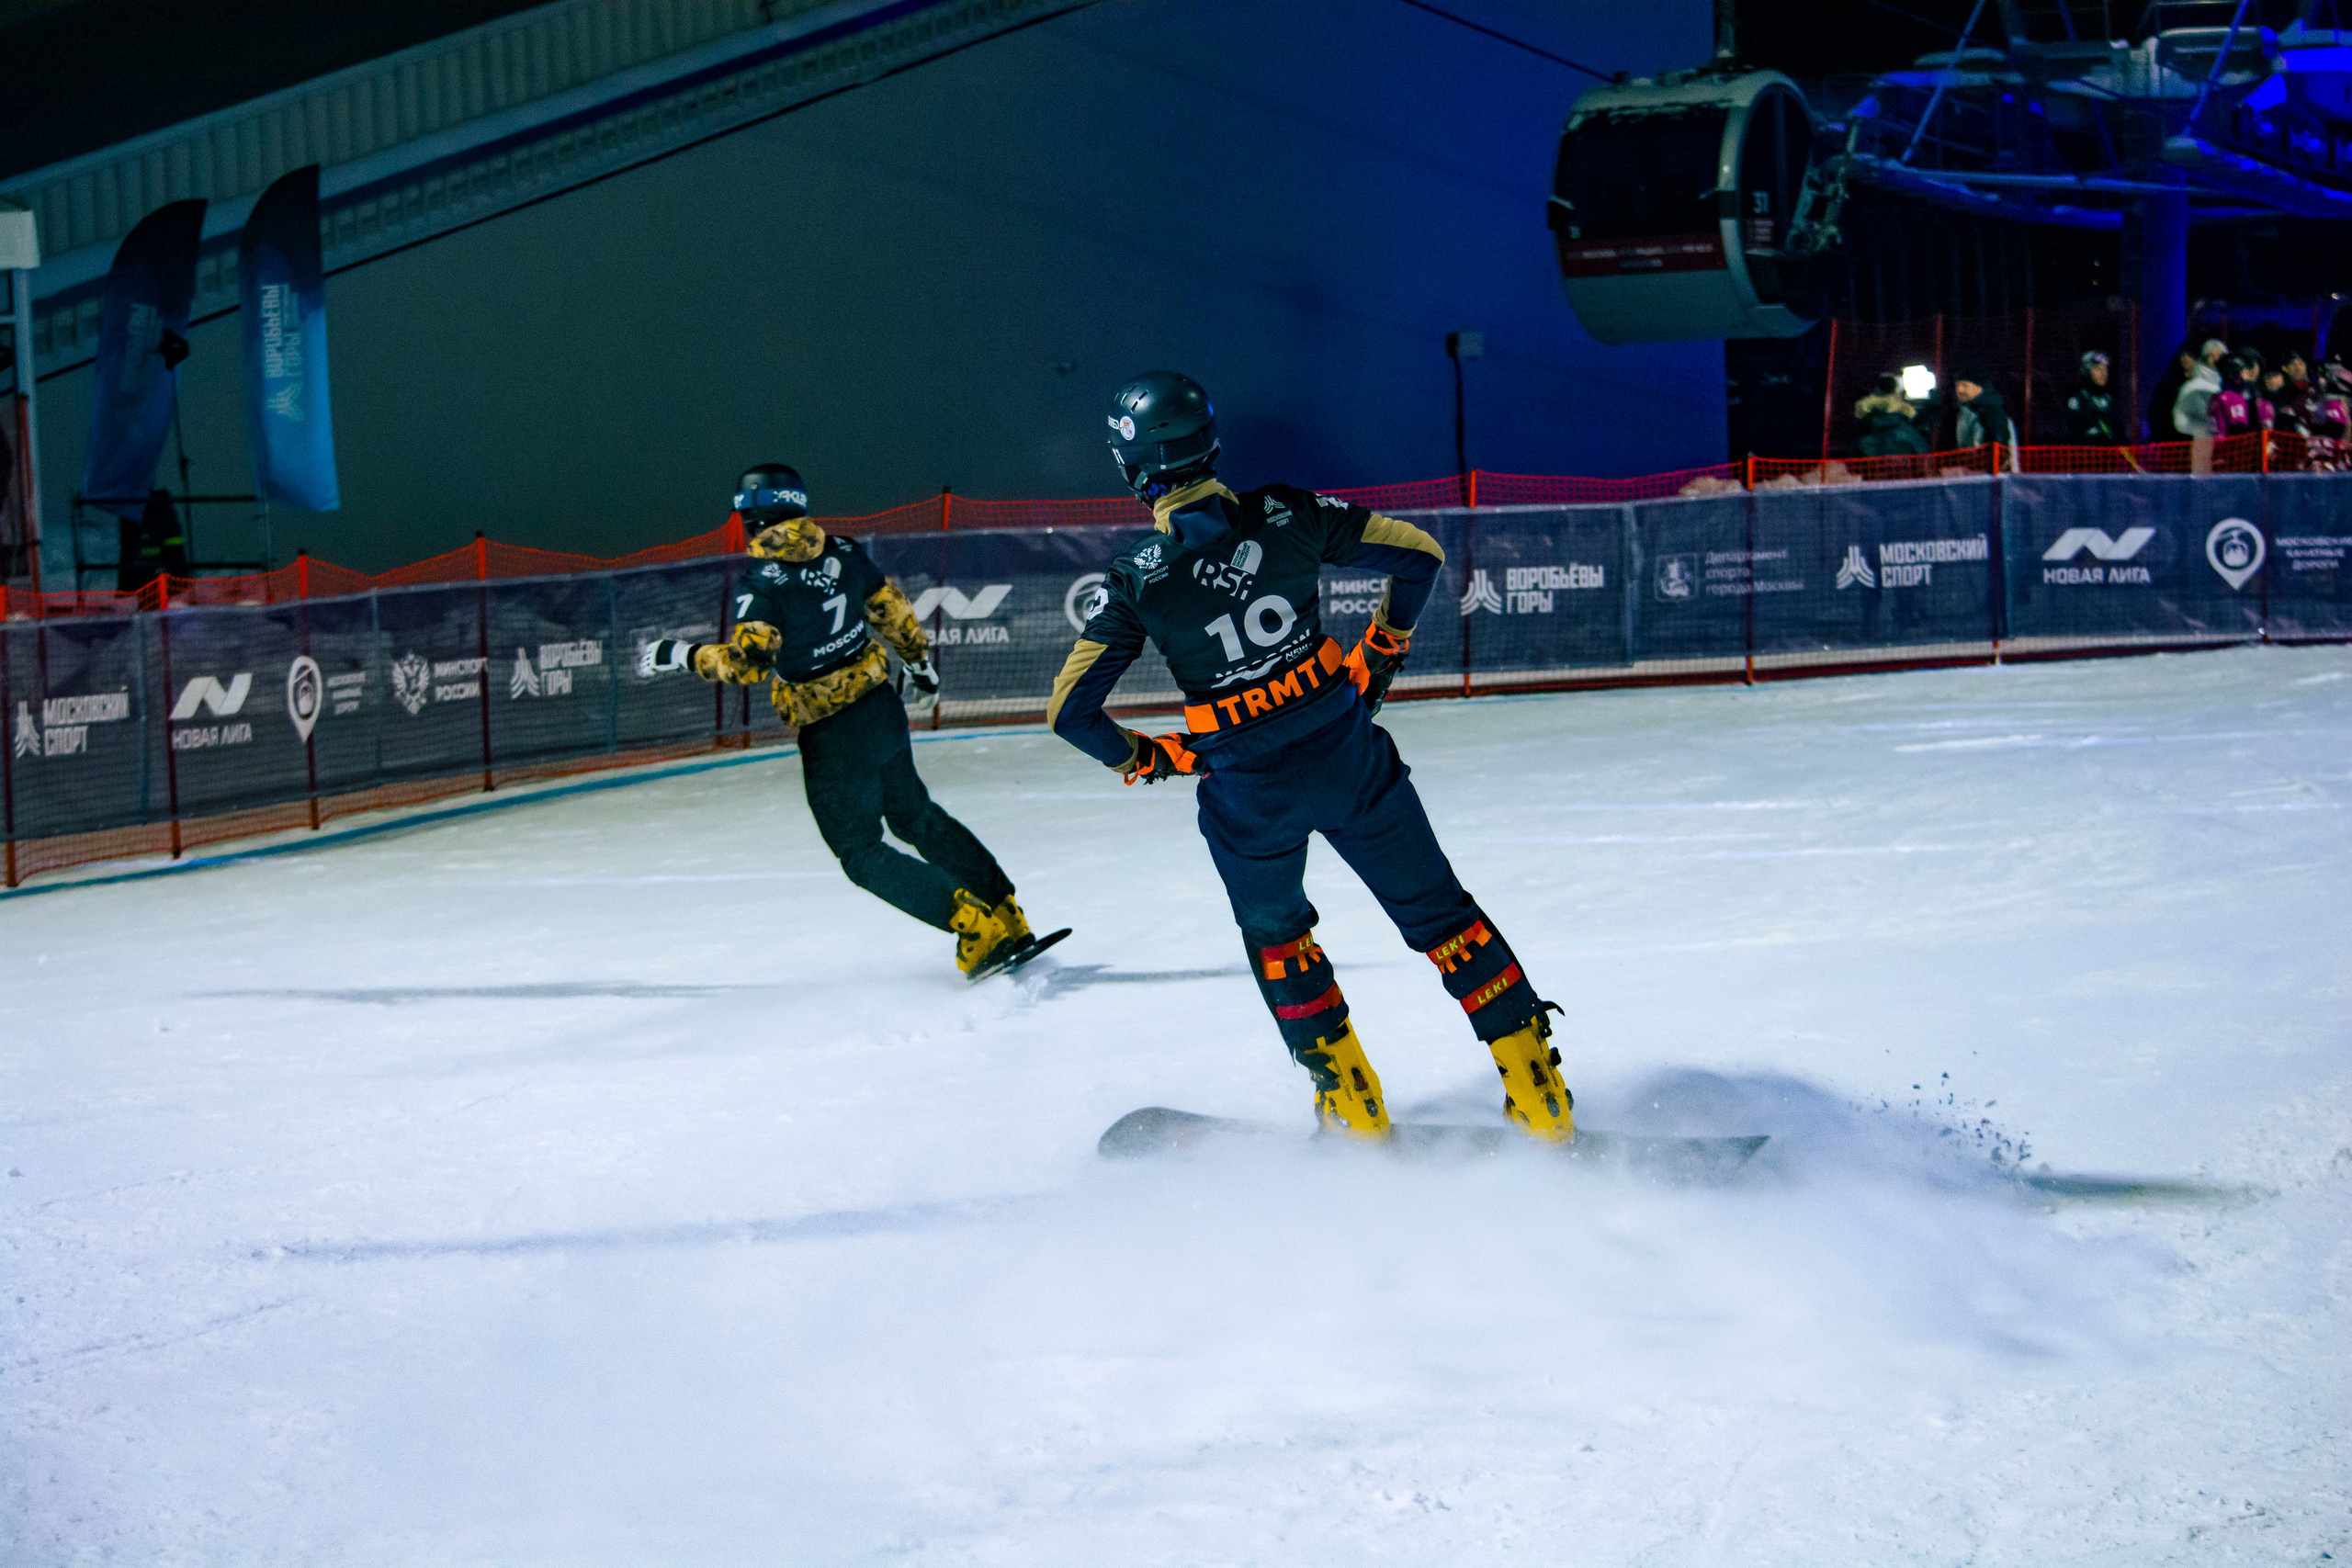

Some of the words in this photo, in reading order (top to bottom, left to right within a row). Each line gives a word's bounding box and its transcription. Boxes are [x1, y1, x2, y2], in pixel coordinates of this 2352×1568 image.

[1879, 533, 1989, 565] МОСКОВСКИЙ
[1329, 578, 1388, 596] МИНСП
[1506, 562, 1604, 591] ВОРОБЬЁВЫ
[1881, 564, 1932, 589] СПОРТ
[2042, 567, 2104, 584] НОВАЯ
[2108, 566, 2152, 584] ЛИГА
[736, 592, 754, 619] 7
[821, 592, 848, 636] 7
[1329, 598, 1380, 615] РОСС
[1506, 591, 1553, 615] ГОРЫ
[813, 619, 865, 658] MOSCOW
[925, 627, 962, 647] ВАЯ
[964, 626, 1010, 645] ЛИГА
[1204, 594, 1297, 662] 10
[435, 681, 481, 702] РОССИИ
[1217, 656, 1322, 727] TRMT
[44, 725, 89, 757] СПОРТ
[173, 726, 219, 750] НОВАЯ
[220, 723, 253, 746] ЛИГА
[1435, 934, 1464, 960] LEKI
[1477, 976, 1508, 1005] LEKI
